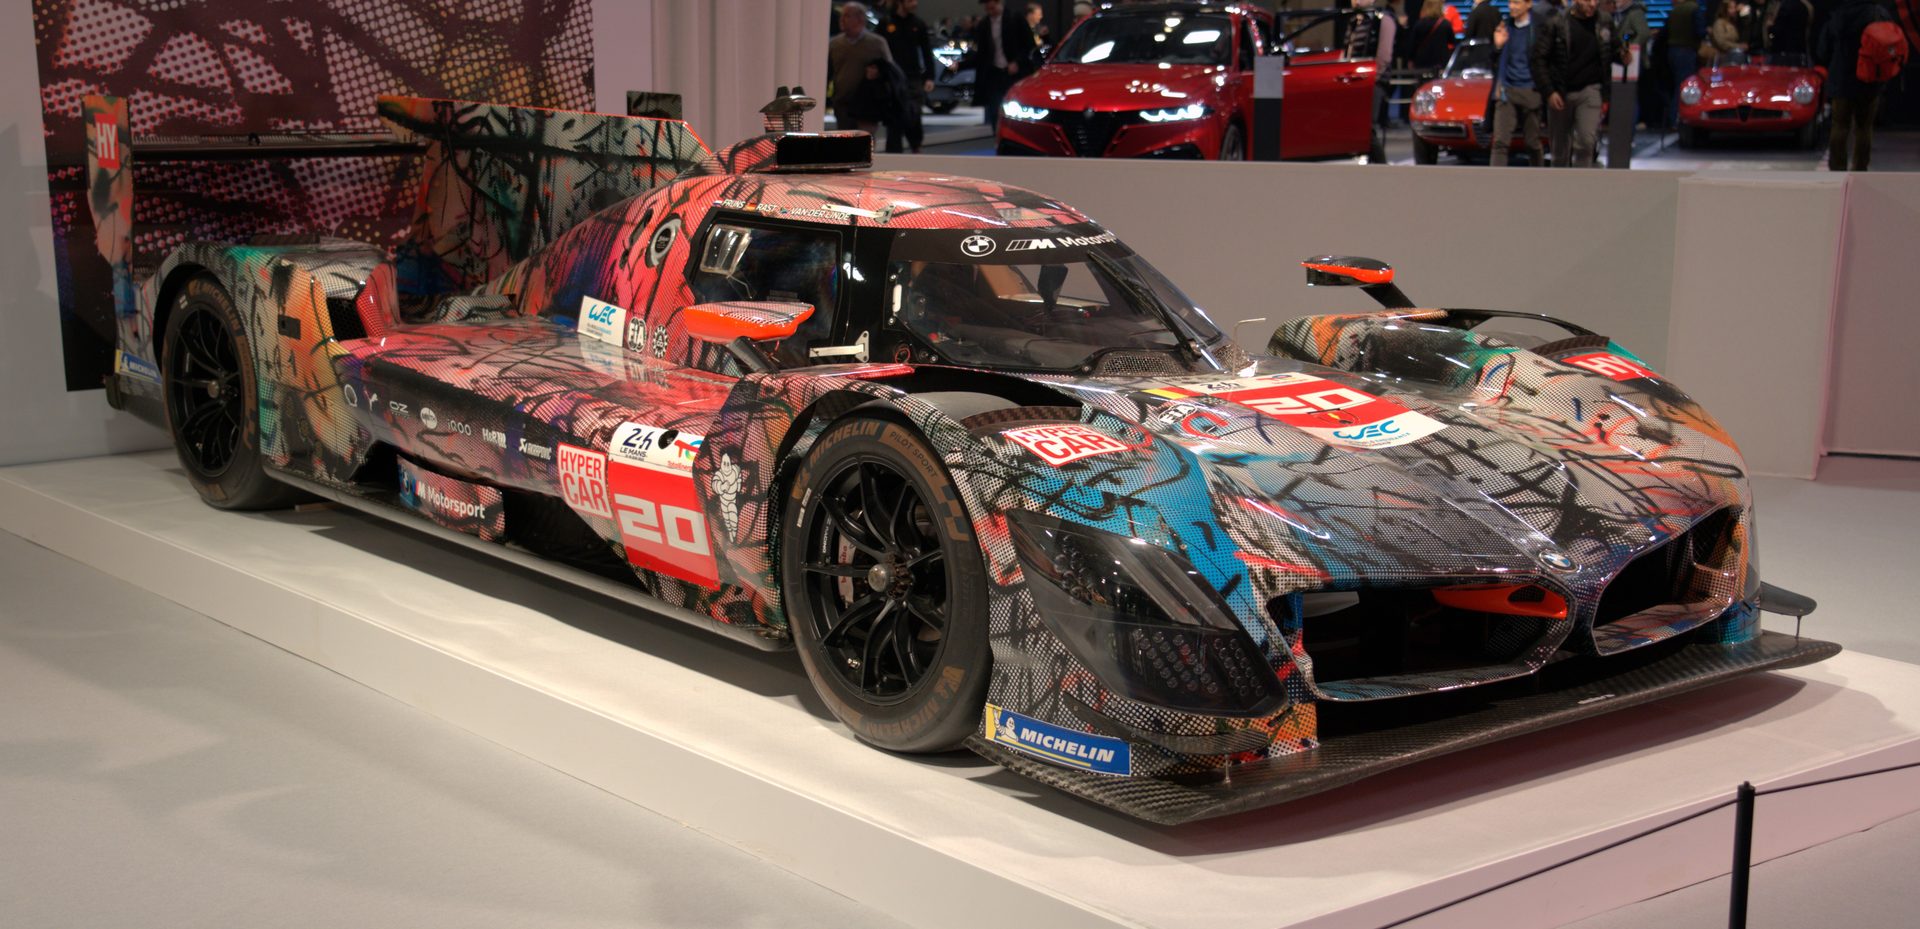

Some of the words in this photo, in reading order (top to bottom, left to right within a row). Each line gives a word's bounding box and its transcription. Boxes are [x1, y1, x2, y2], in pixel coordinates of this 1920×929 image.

[96, 122, 117, 160] HY
[756, 203, 778, 212] RAST
[791, 207, 807, 216] VAN
[808, 209, 825, 218] DER
[825, 211, 850, 220] LINDE
[588, 303, 617, 326] WEC
[628, 322, 645, 348] FIA
[1574, 355, 1642, 377] HY
[389, 401, 409, 414] OZ
[1159, 404, 1197, 425] FIA
[1239, 388, 1377, 415] 20
[1016, 426, 1094, 443] HYPER
[1332, 419, 1401, 440] WEC
[619, 447, 628, 455] LE
[628, 448, 648, 459] MANS
[810, 422, 881, 467] MICHELIN
[889, 431, 913, 452] PILOT
[912, 446, 939, 479] SPORT
[1034, 433, 1121, 460] CAR
[560, 448, 602, 479] HYPER
[427, 486, 486, 520] Motorsport
[562, 472, 609, 514] CAR
[614, 493, 711, 556] 20
[1020, 727, 1115, 764] MICHELIN
